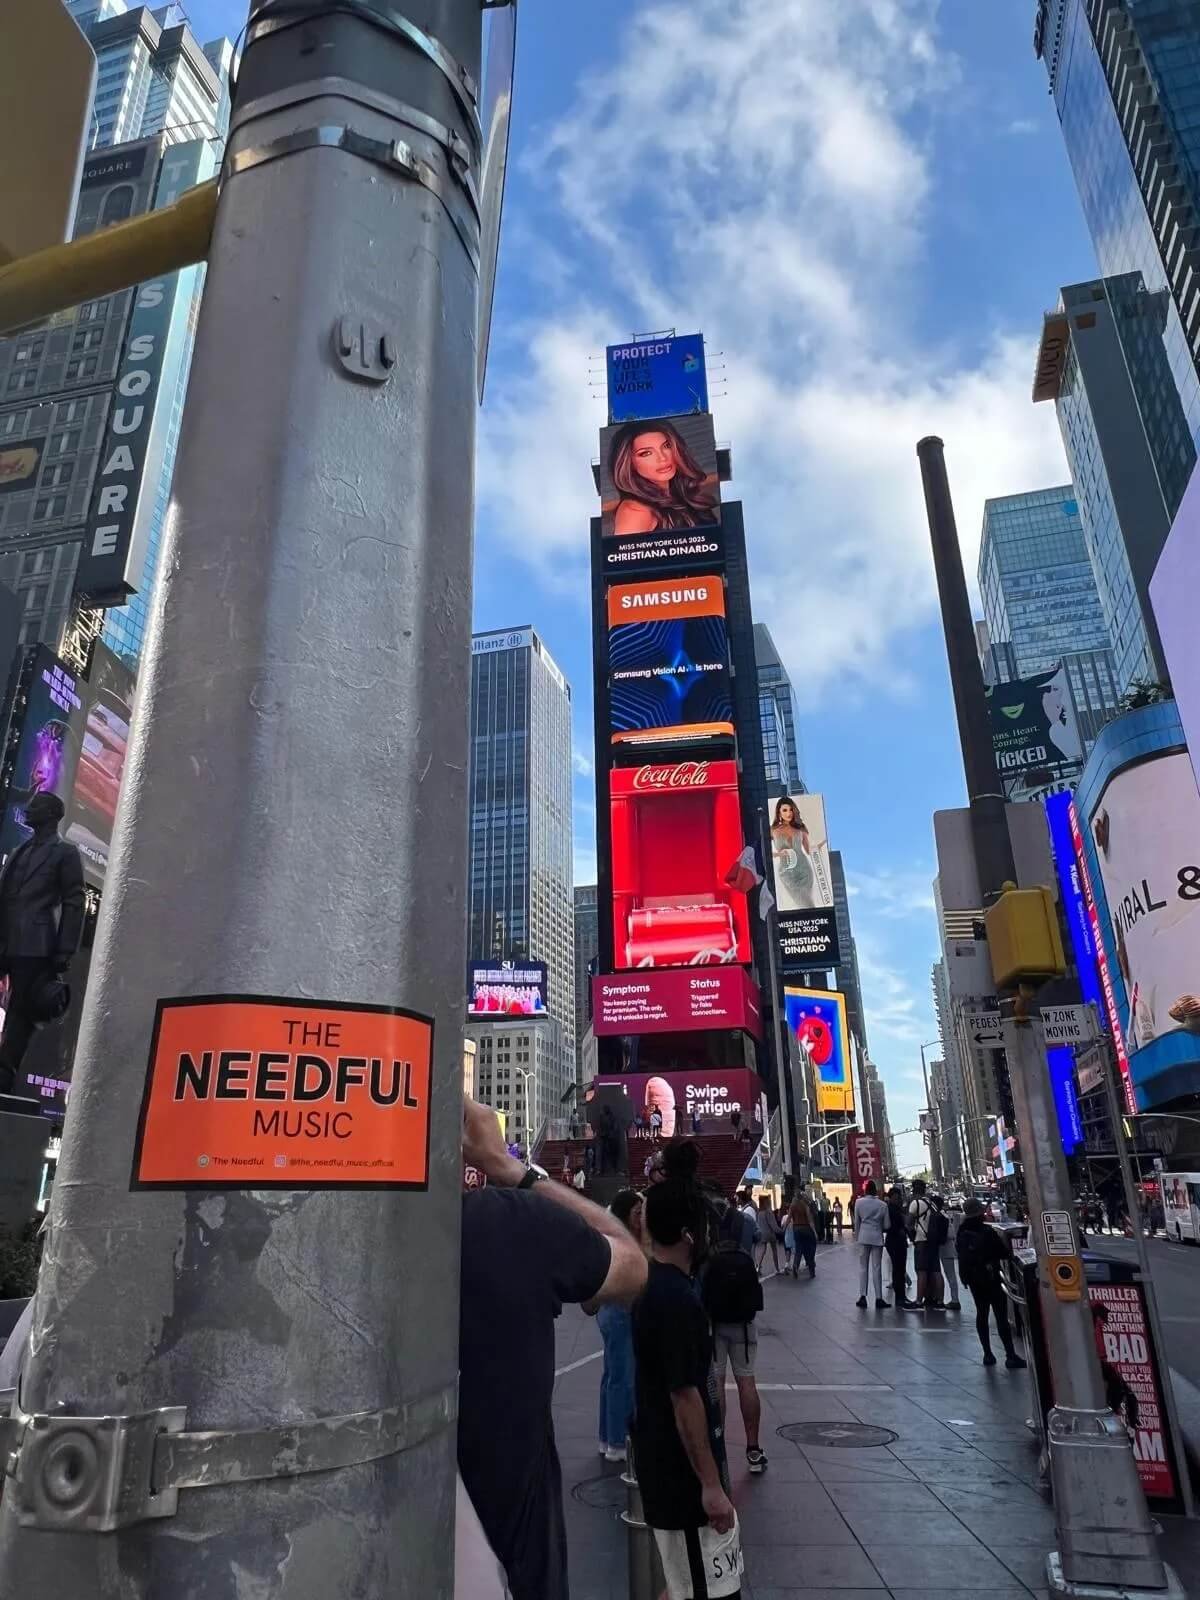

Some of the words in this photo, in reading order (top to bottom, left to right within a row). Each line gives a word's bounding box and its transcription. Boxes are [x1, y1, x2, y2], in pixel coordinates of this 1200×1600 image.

[613, 343, 672, 361] PROTECT
[615, 381, 654, 395] WORK
[91, 334, 155, 557] SQUARE
[673, 538, 688, 546] USA
[607, 548, 668, 562] CHRISTIANA
[669, 543, 719, 556] DINARDO
[621, 588, 708, 609] SAMSUNG
[472, 637, 505, 651] llianz
[614, 669, 651, 680] Samsung
[652, 667, 676, 676] Vision
[695, 664, 703, 672] is
[703, 663, 723, 671] here
[1115, 879, 1167, 933] VIRAL
[1177, 866, 1200, 900] &
[779, 935, 831, 946] CHRISTIANA
[785, 944, 826, 954] DINARDO
[602, 985, 650, 997] Symptoms
[690, 979, 720, 989] Status
[1053, 1010, 1076, 1022] ZONE
[283, 1020, 342, 1048] THE
[1046, 1025, 1080, 1037] MOVING
[173, 1050, 419, 1109] NEEDFUL
[685, 1084, 729, 1099] Swipe
[686, 1100, 741, 1116] Fatigue
[253, 1109, 353, 1138] MUSIC
[212, 1156, 229, 1165] The
[231, 1156, 265, 1165] Needful
[855, 1136, 875, 1177] tkts
[1088, 1288, 1139, 1301] THRILLER
[1103, 1333, 1148, 1364] BAD
[1122, 1373, 1153, 1383] BACK
